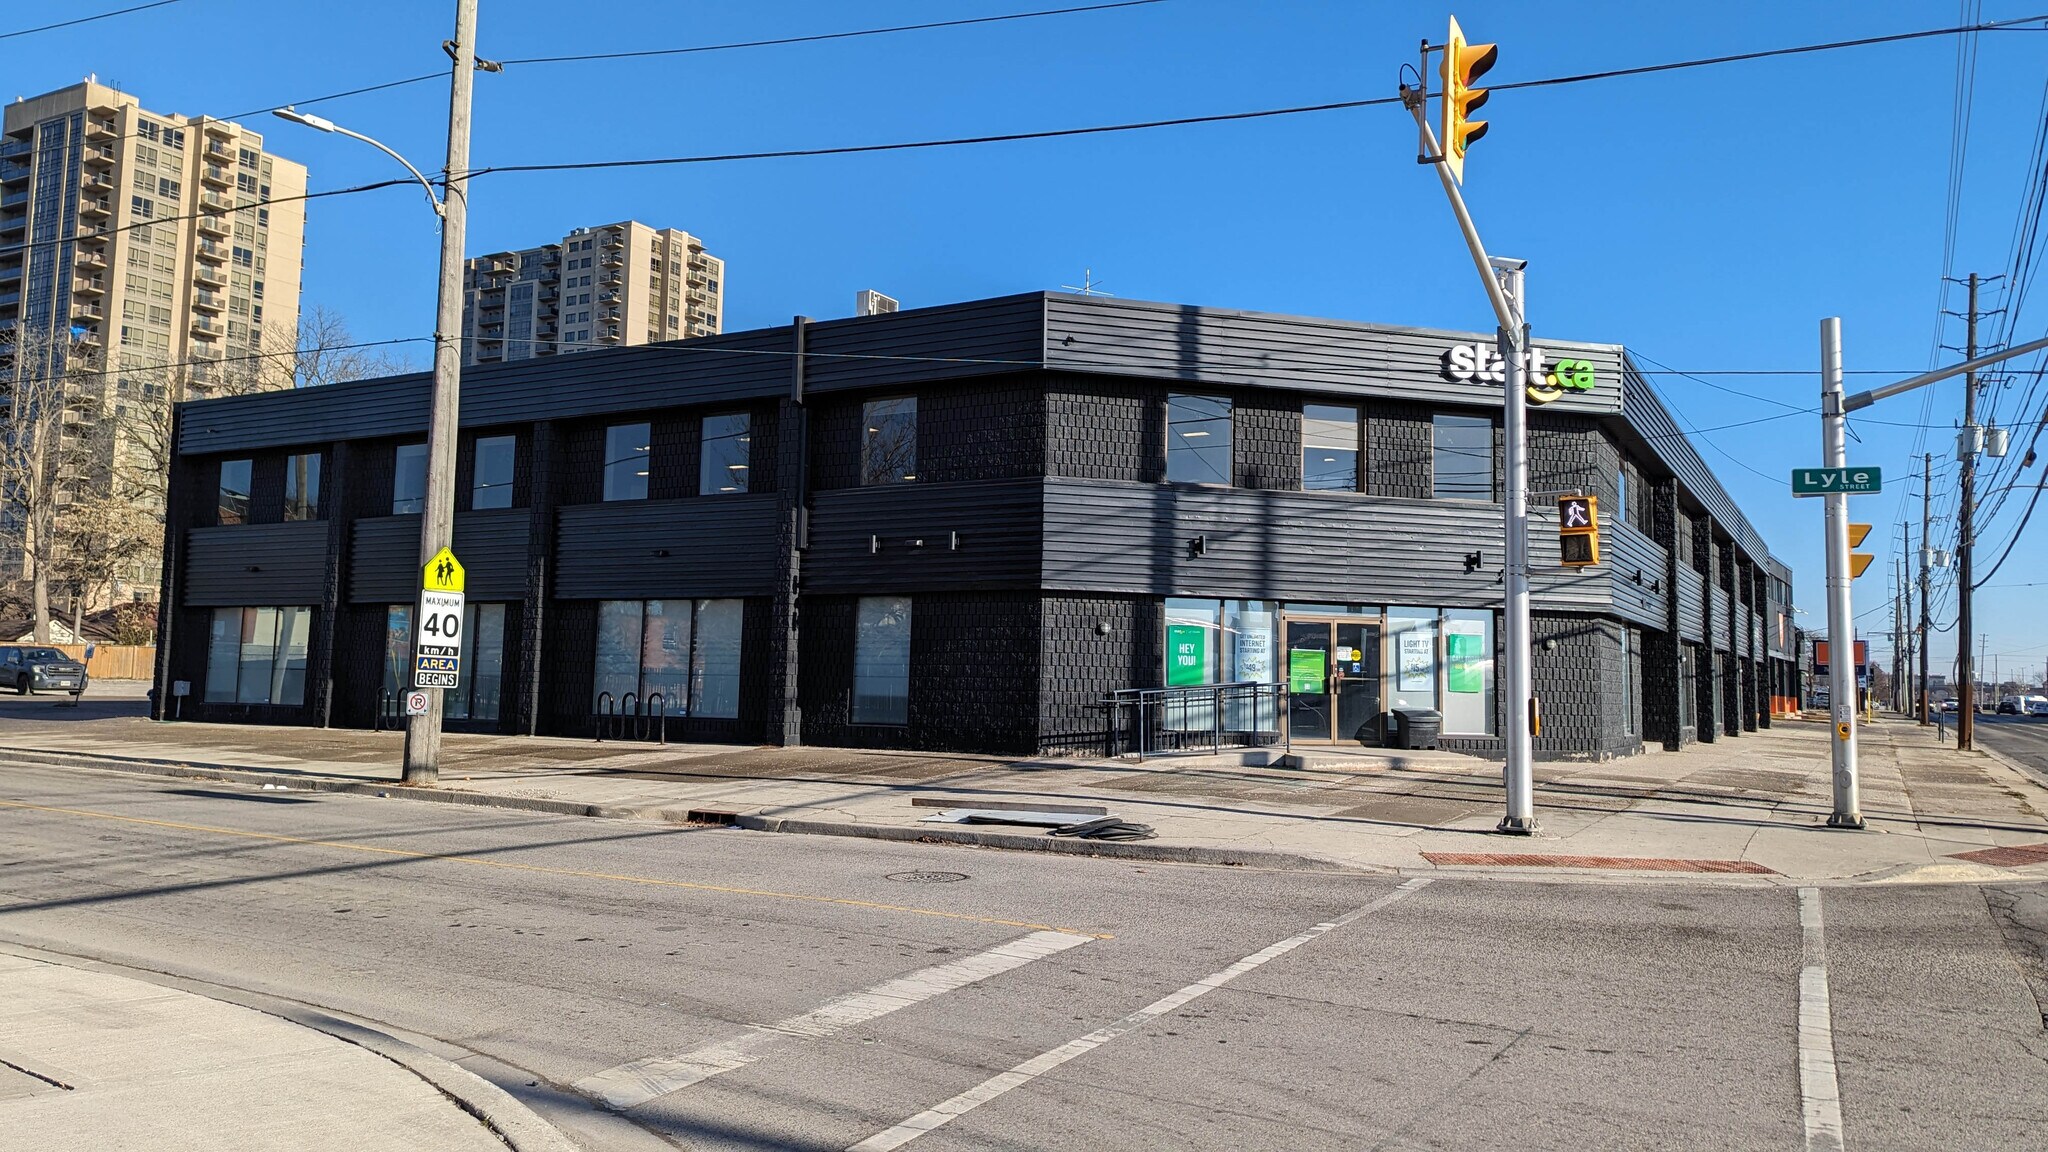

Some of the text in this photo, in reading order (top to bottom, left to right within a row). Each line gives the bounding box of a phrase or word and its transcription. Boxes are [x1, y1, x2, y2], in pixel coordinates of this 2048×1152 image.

[1449, 342, 1595, 389] stat.ca
[1804, 471, 1869, 488] Lyle
[425, 596, 460, 607] MAXIMUM
[423, 612, 459, 638] 40
[1179, 643, 1195, 654] HEY
[1404, 640, 1421, 648] LIGHT
[423, 646, 454, 656] km/h
[420, 659, 455, 670] AREA
[1177, 655, 1196, 666] YOU!
[418, 673, 455, 686] BEGINS
